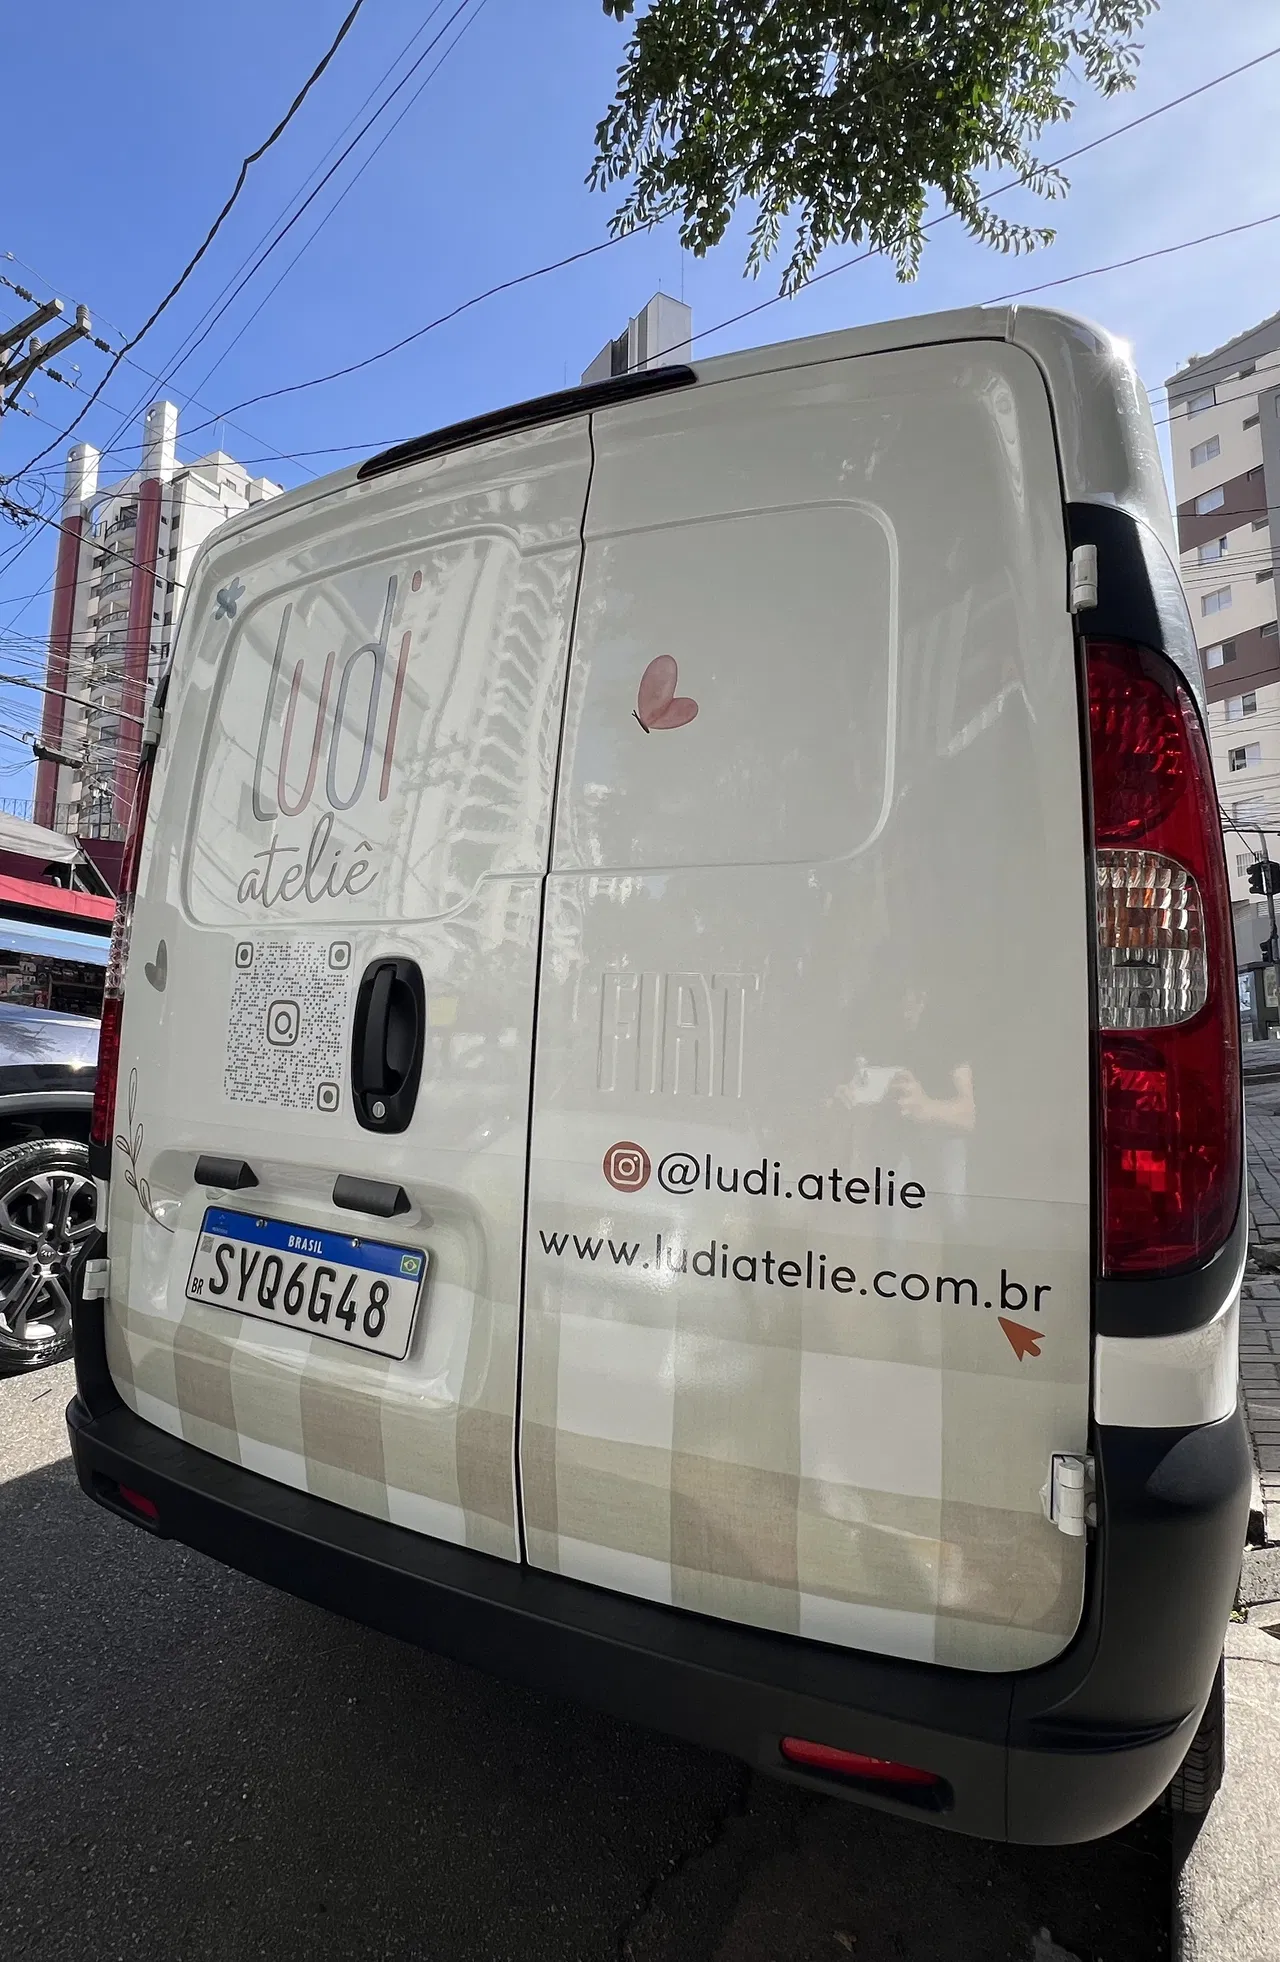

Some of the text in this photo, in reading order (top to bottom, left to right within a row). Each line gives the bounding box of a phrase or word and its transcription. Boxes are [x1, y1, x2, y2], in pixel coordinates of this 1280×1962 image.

[237, 811, 380, 908] ateliê
[597, 971, 761, 1099] FIAT
[657, 1152, 926, 1209] @ludi.atelie
[287, 1234, 323, 1254] BRASIL
[539, 1229, 1053, 1312] www.ludiatelie.com.br
[190, 1276, 205, 1296] BR
[208, 1243, 390, 1338] SYQ6G48
